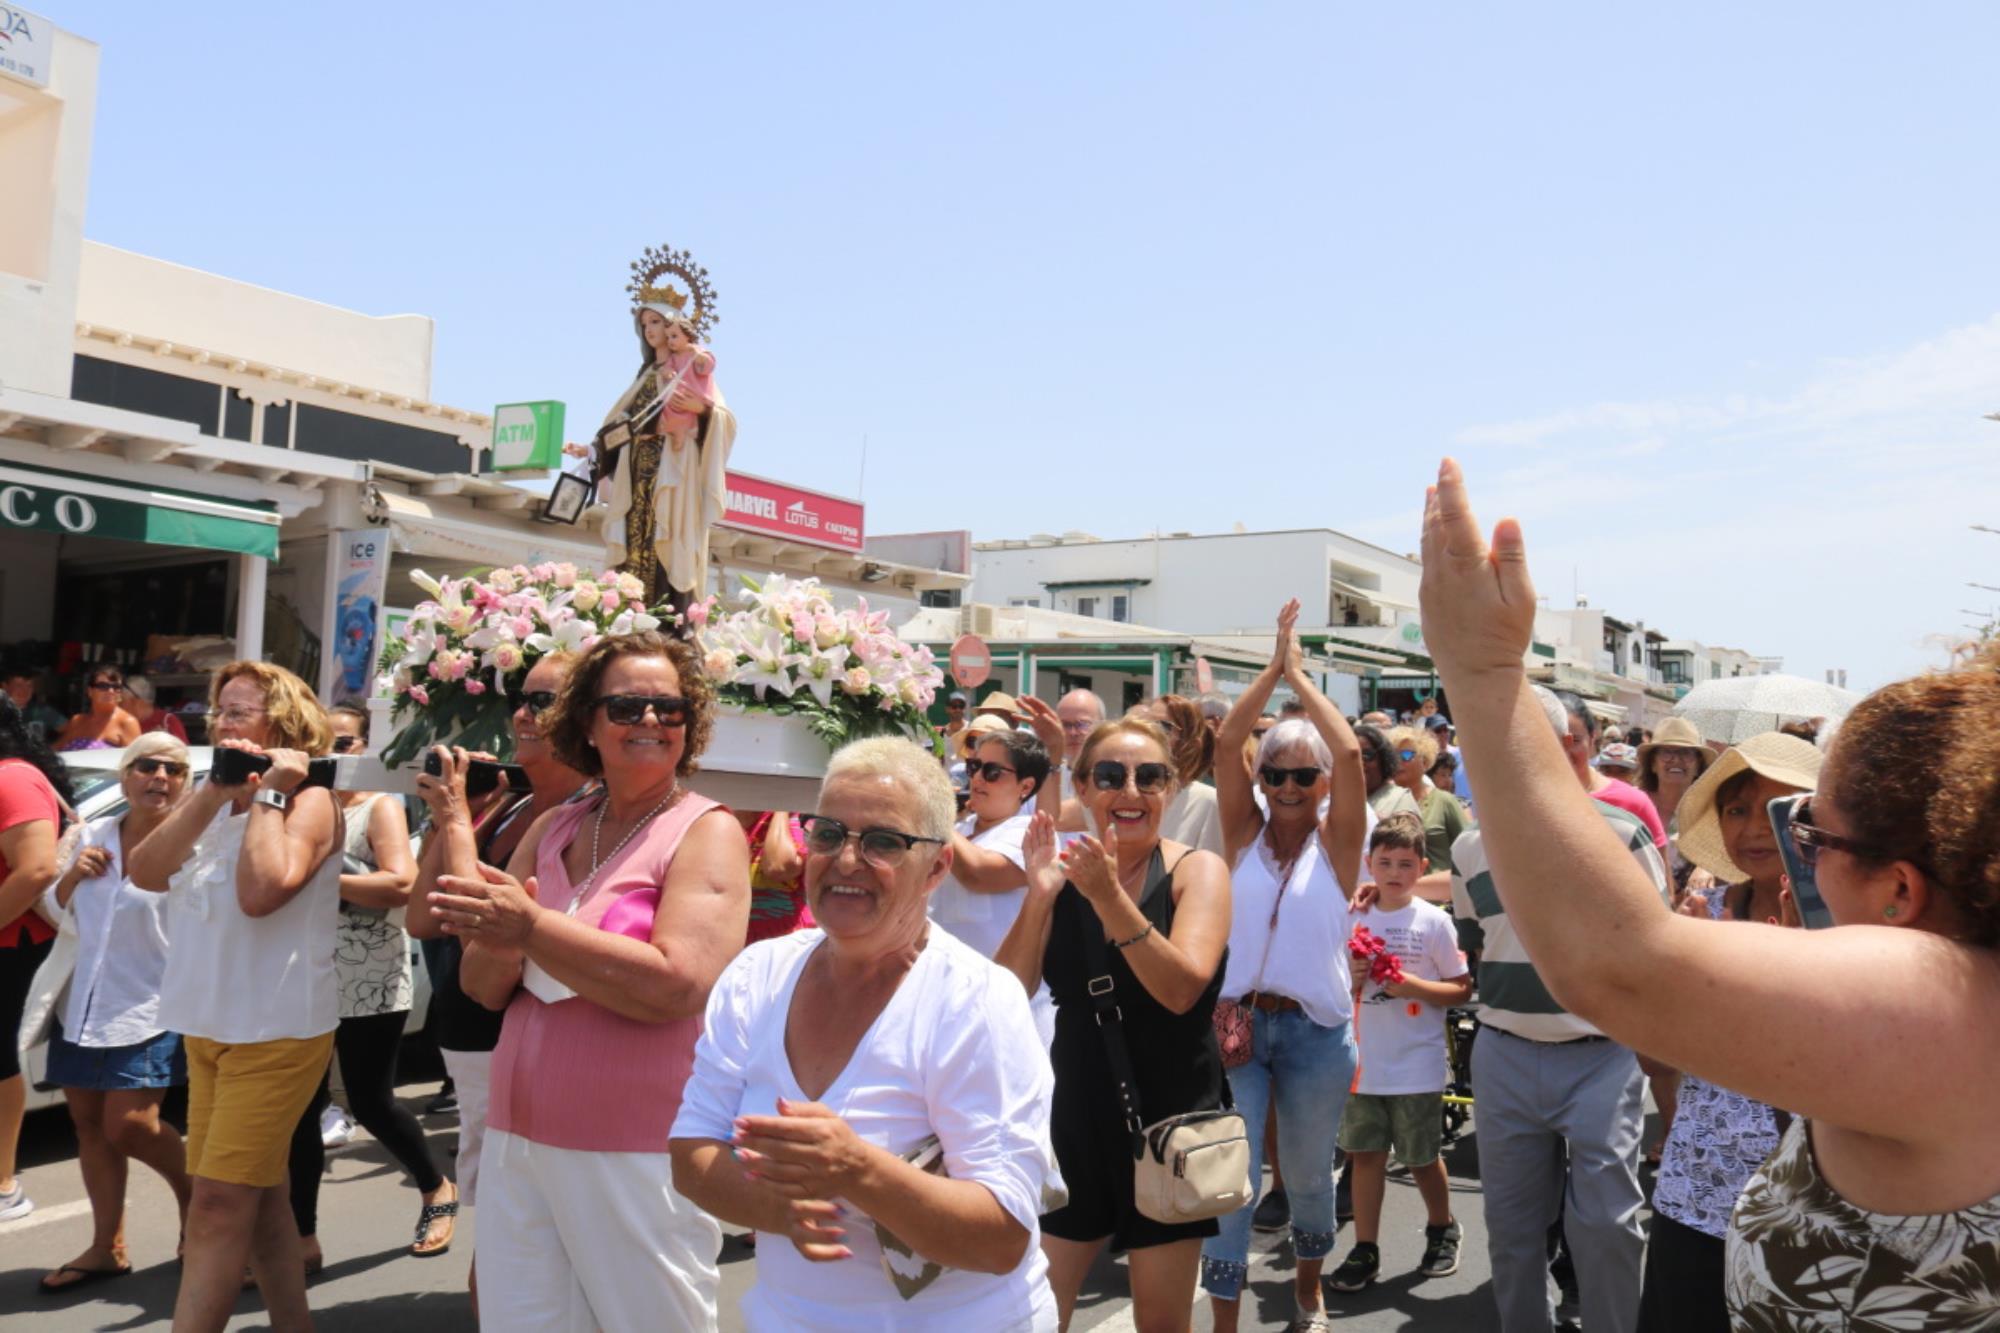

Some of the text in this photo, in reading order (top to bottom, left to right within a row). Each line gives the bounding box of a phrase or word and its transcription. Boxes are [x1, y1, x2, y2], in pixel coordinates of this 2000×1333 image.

[496, 423, 534, 444] ATM
[724, 489, 778, 521] MARVEL
[784, 510, 819, 529] LOTUS
[351, 542, 376, 559] ice
